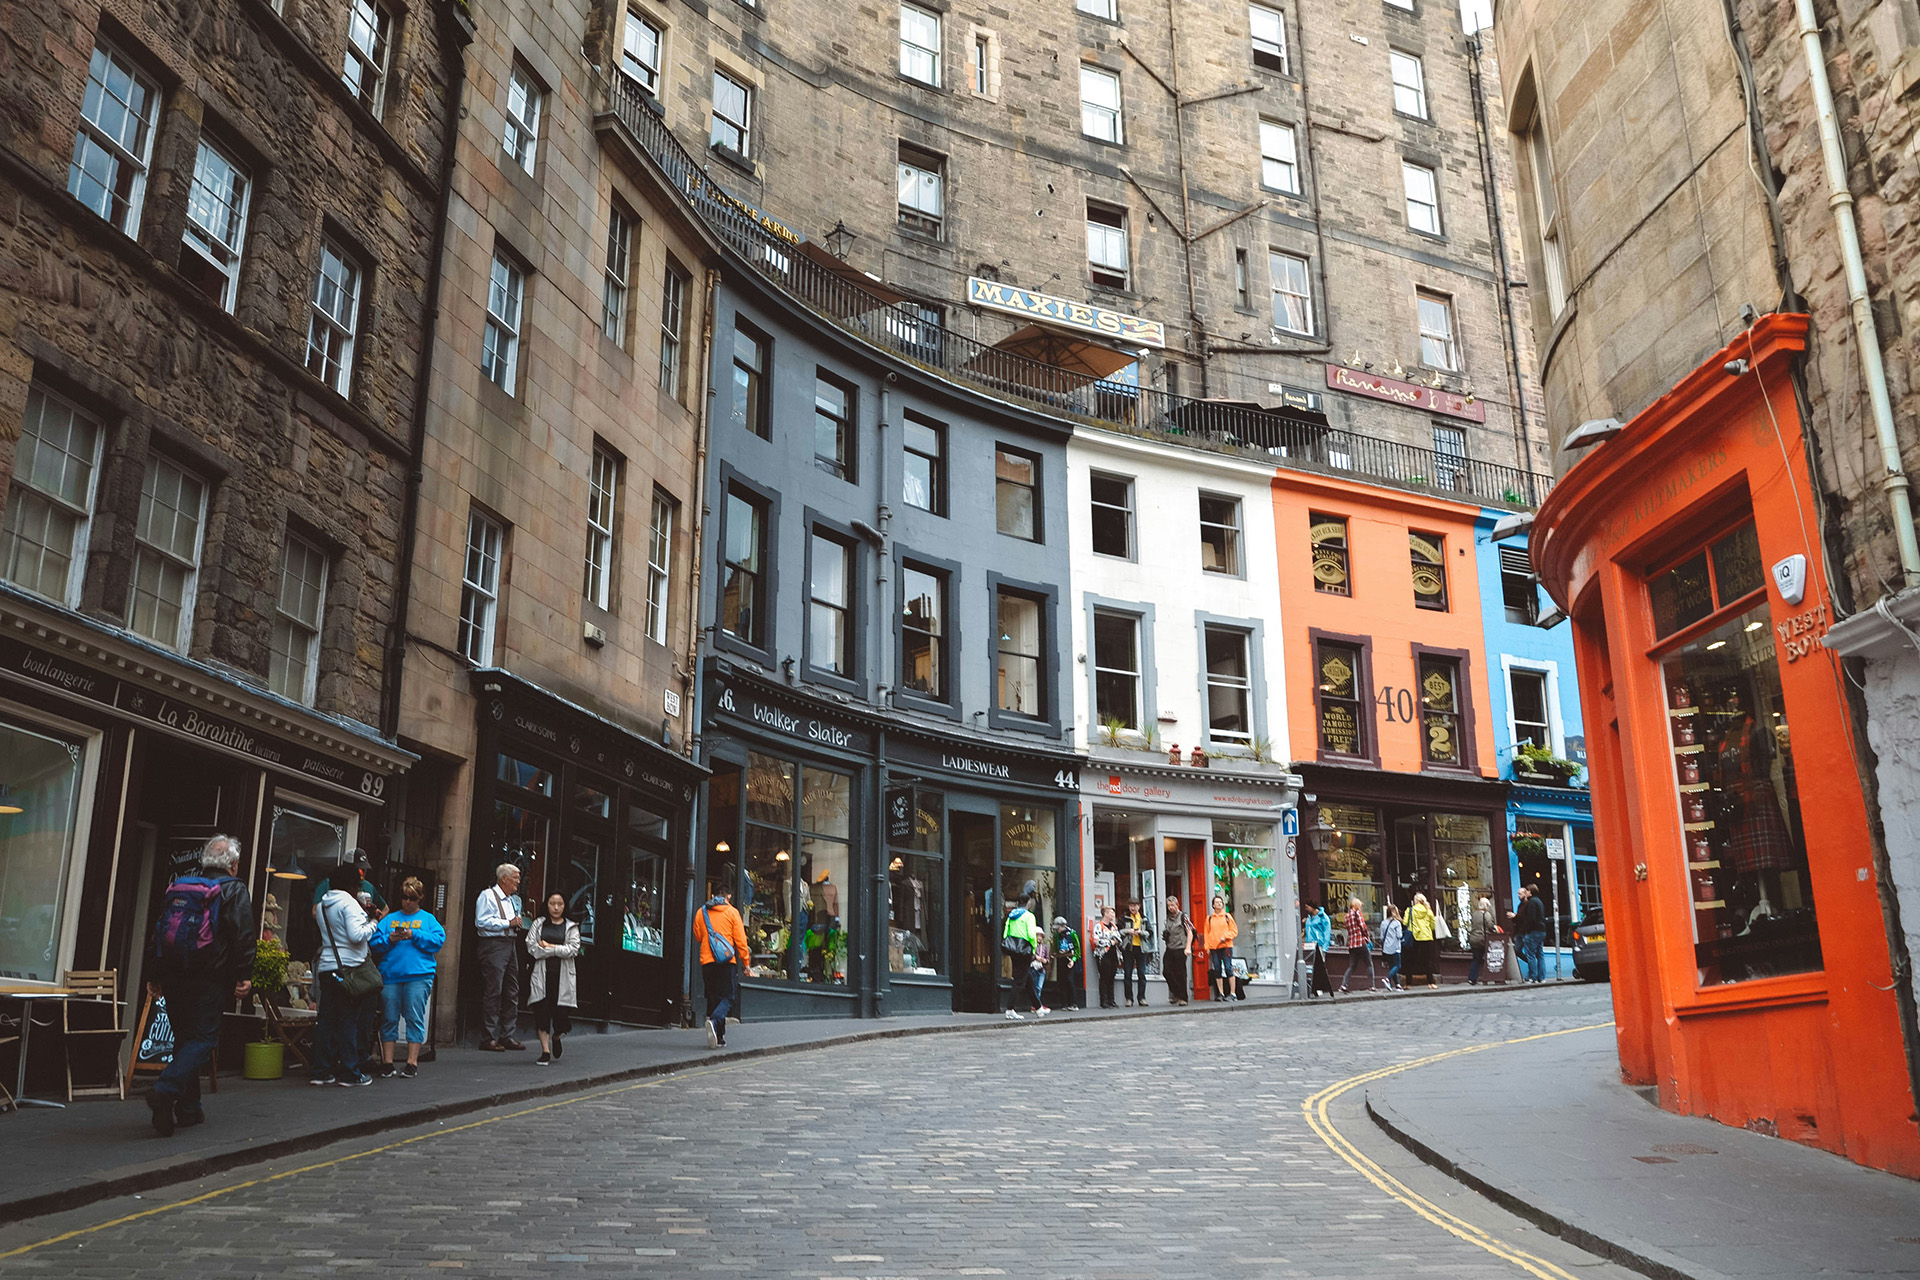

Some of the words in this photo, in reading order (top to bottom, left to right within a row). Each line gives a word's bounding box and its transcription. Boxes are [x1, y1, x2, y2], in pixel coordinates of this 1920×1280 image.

[761, 216, 800, 244] ARMS
[974, 281, 1122, 334] MAXIES
[1634, 445, 1727, 523] KILTMAKERS
[1777, 605, 1826, 643] WEST
[1785, 628, 1823, 663] BOW
[22, 650, 95, 692] boulangerie
[1429, 681, 1445, 691] BEST
[157, 700, 178, 726] La
[1324, 712, 1352, 721] WORLD
[1376, 686, 1413, 724] 40
[515, 716, 557, 742] CLARKSONS
[753, 703, 800, 733] Walker
[808, 720, 852, 747] Slater
[1322, 727, 1357, 736] ADMISSION
[1429, 726, 1451, 753] 2
[942, 754, 1010, 778] LADIESWEAR
[361, 772, 384, 797] 89
[641, 771, 674, 792] CLARKSONS
[1054, 769, 1080, 790] 44.
[1097, 780, 1109, 791] the
[1109, 781, 1121, 792] red
[1122, 783, 1140, 794] door
[1143, 785, 1171, 798] gallery
